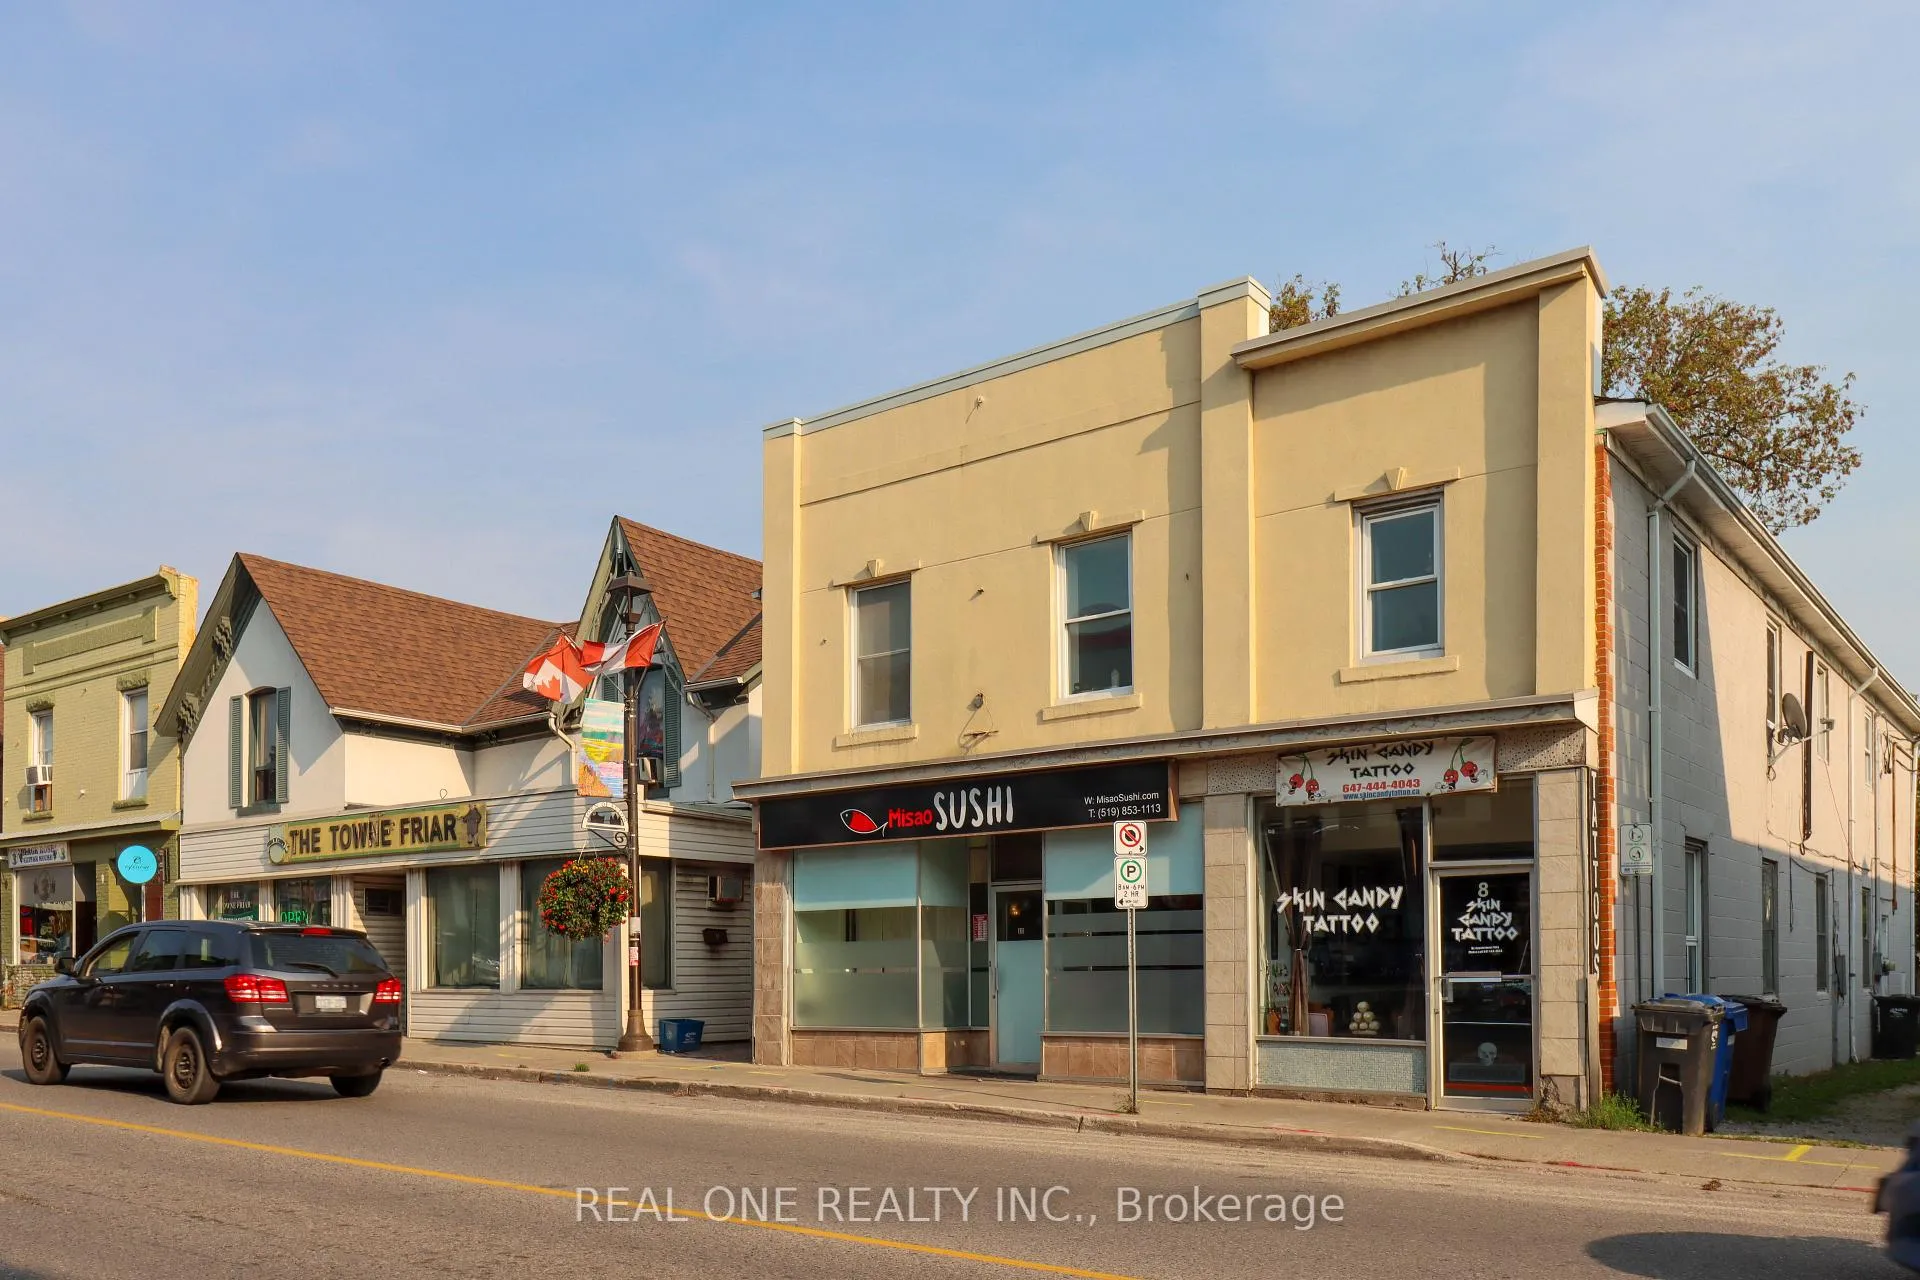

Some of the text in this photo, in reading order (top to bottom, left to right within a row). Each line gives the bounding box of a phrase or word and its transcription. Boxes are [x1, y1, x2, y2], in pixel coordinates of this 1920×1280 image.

[1327, 740, 1435, 766] SKIN CANDY
[1349, 763, 1415, 779] TATTOO
[1342, 779, 1421, 793] 647-444-4043
[1343, 788, 1420, 800] www.skincandytattoo.ca
[1084, 792, 1159, 805] W: MisaoSushi.com
[888, 785, 1014, 831] Misao SUSHI
[1088, 803, 1161, 819] T: (519) 853-1113
[289, 827, 321, 855] THE
[328, 819, 391, 850] TOWNE
[400, 813, 457, 845] FRIAR
[1127, 865, 1137, 878] P
[1590, 770, 1600, 984] TATTOOS
[1123, 890, 1139, 898] 2 HR
[1477, 882, 1489, 898] 8
[1277, 885, 1404, 914] SKIN CANDY
[1466, 898, 1501, 912] SKIN
[1302, 912, 1380, 935] TATTOO
[1457, 911, 1513, 928] CANDY
[1450, 926, 1518, 943] TATTOO
